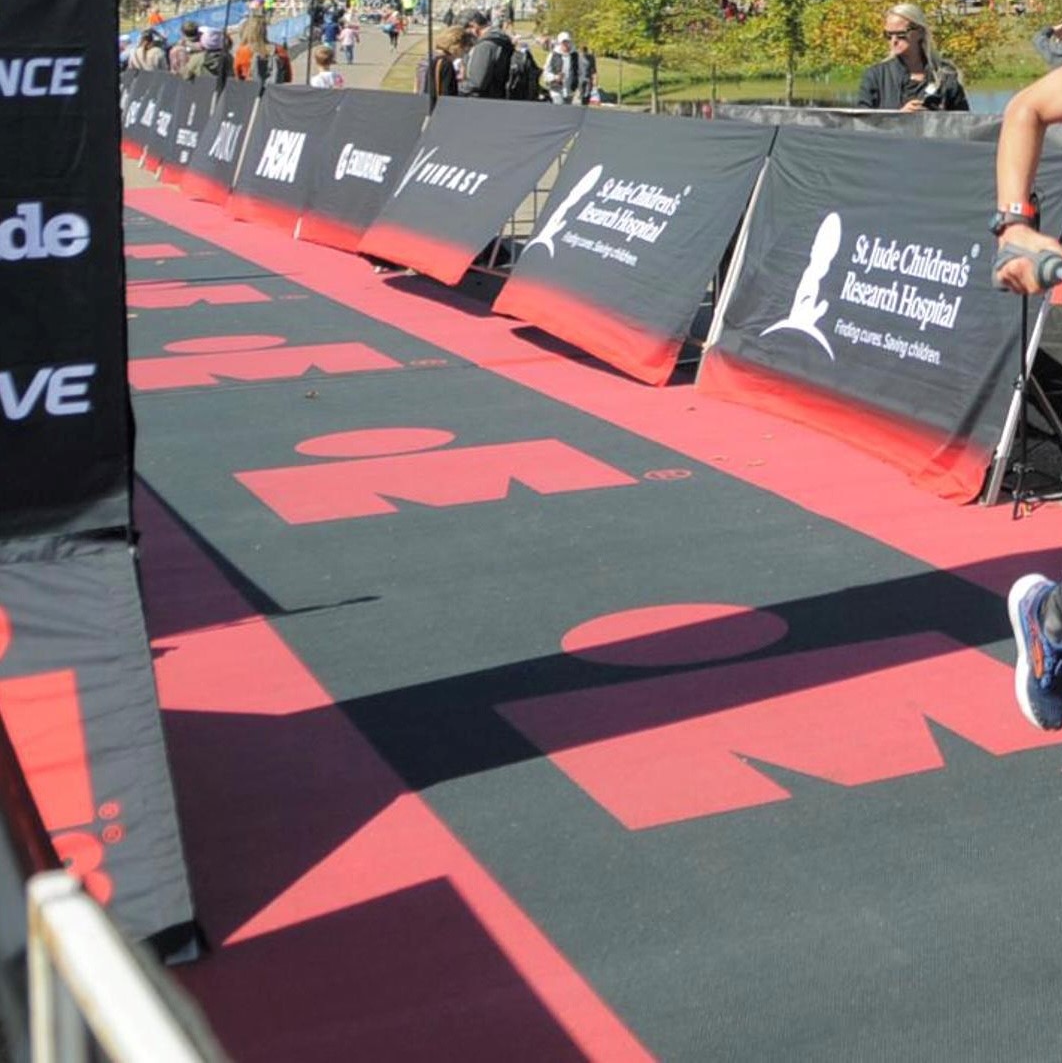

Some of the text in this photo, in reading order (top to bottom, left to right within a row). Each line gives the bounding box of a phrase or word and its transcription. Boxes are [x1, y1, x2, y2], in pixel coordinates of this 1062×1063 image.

[415, 162, 489, 196] VINFAST
[865, 238, 901, 275] Jude
[899, 244, 971, 288] Children's
[840, 271, 963, 331] Research Hospital
